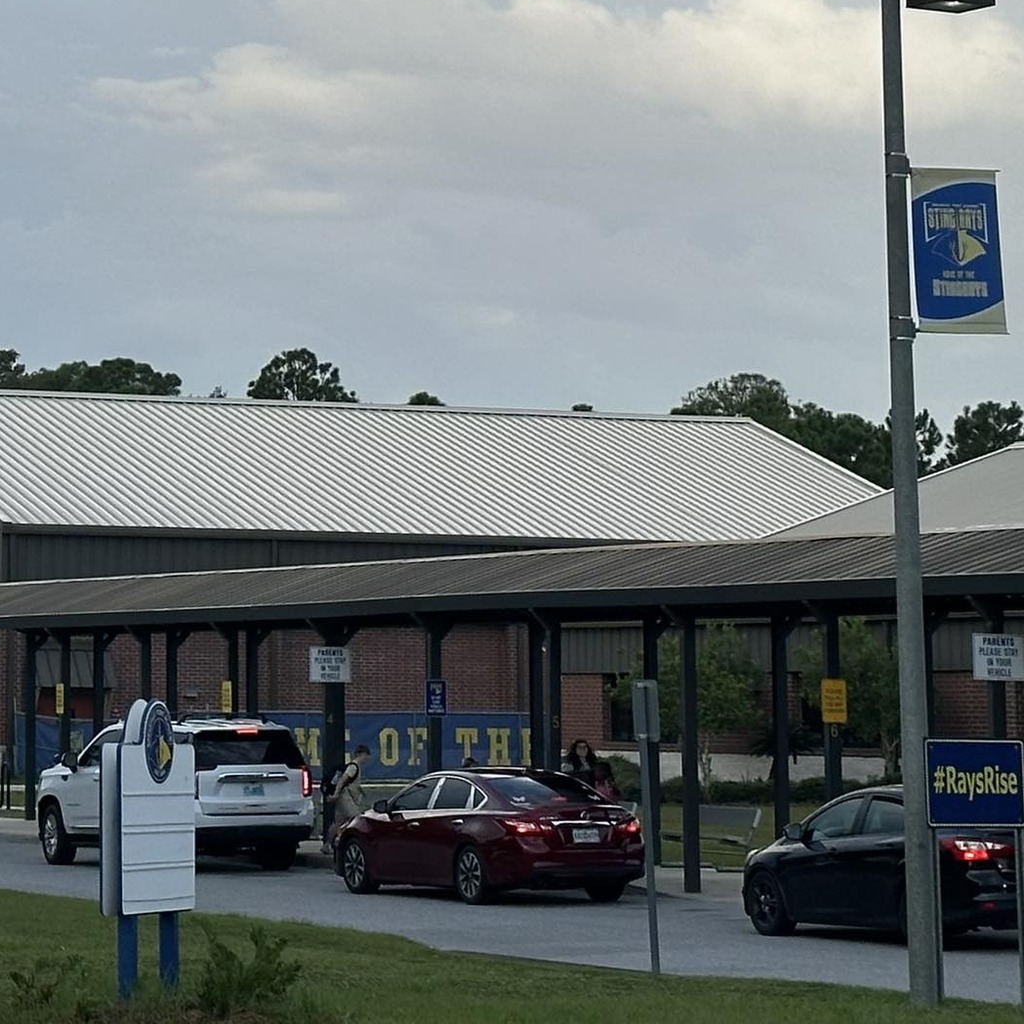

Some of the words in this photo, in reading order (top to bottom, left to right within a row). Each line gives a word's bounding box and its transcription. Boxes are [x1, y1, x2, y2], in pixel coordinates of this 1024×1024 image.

[982, 637, 1015, 647] PARENTS
[979, 647, 1002, 656] PLEASE
[1004, 648, 1019, 657] STAY
[987, 657, 993, 666] IN
[995, 658, 1012, 667] YOUR
[987, 668, 1012, 677] VEHICLE
[326, 713, 333, 724] 4
[831, 724, 839, 738] 6
[379, 727, 428, 766] OF
[933, 764, 1019, 801] #RaysRise
